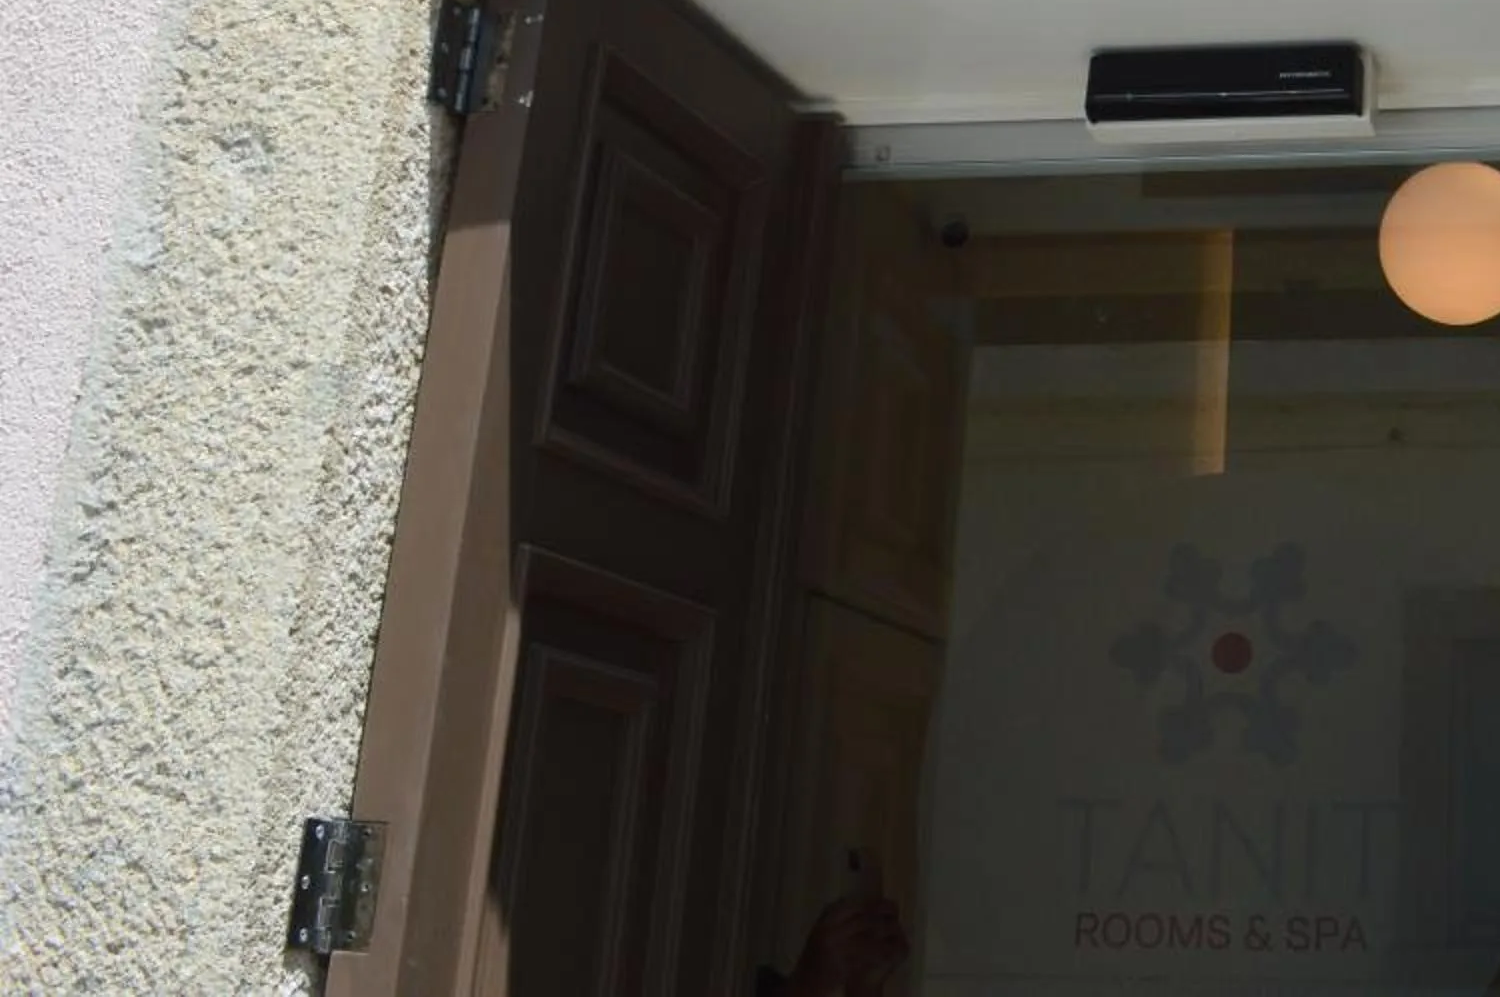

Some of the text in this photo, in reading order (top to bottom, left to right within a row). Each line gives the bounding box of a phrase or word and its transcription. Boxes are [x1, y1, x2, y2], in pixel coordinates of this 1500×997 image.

[1057, 797, 1408, 898] TANIT
[1074, 911, 1369, 952] ROOMS & SPA
